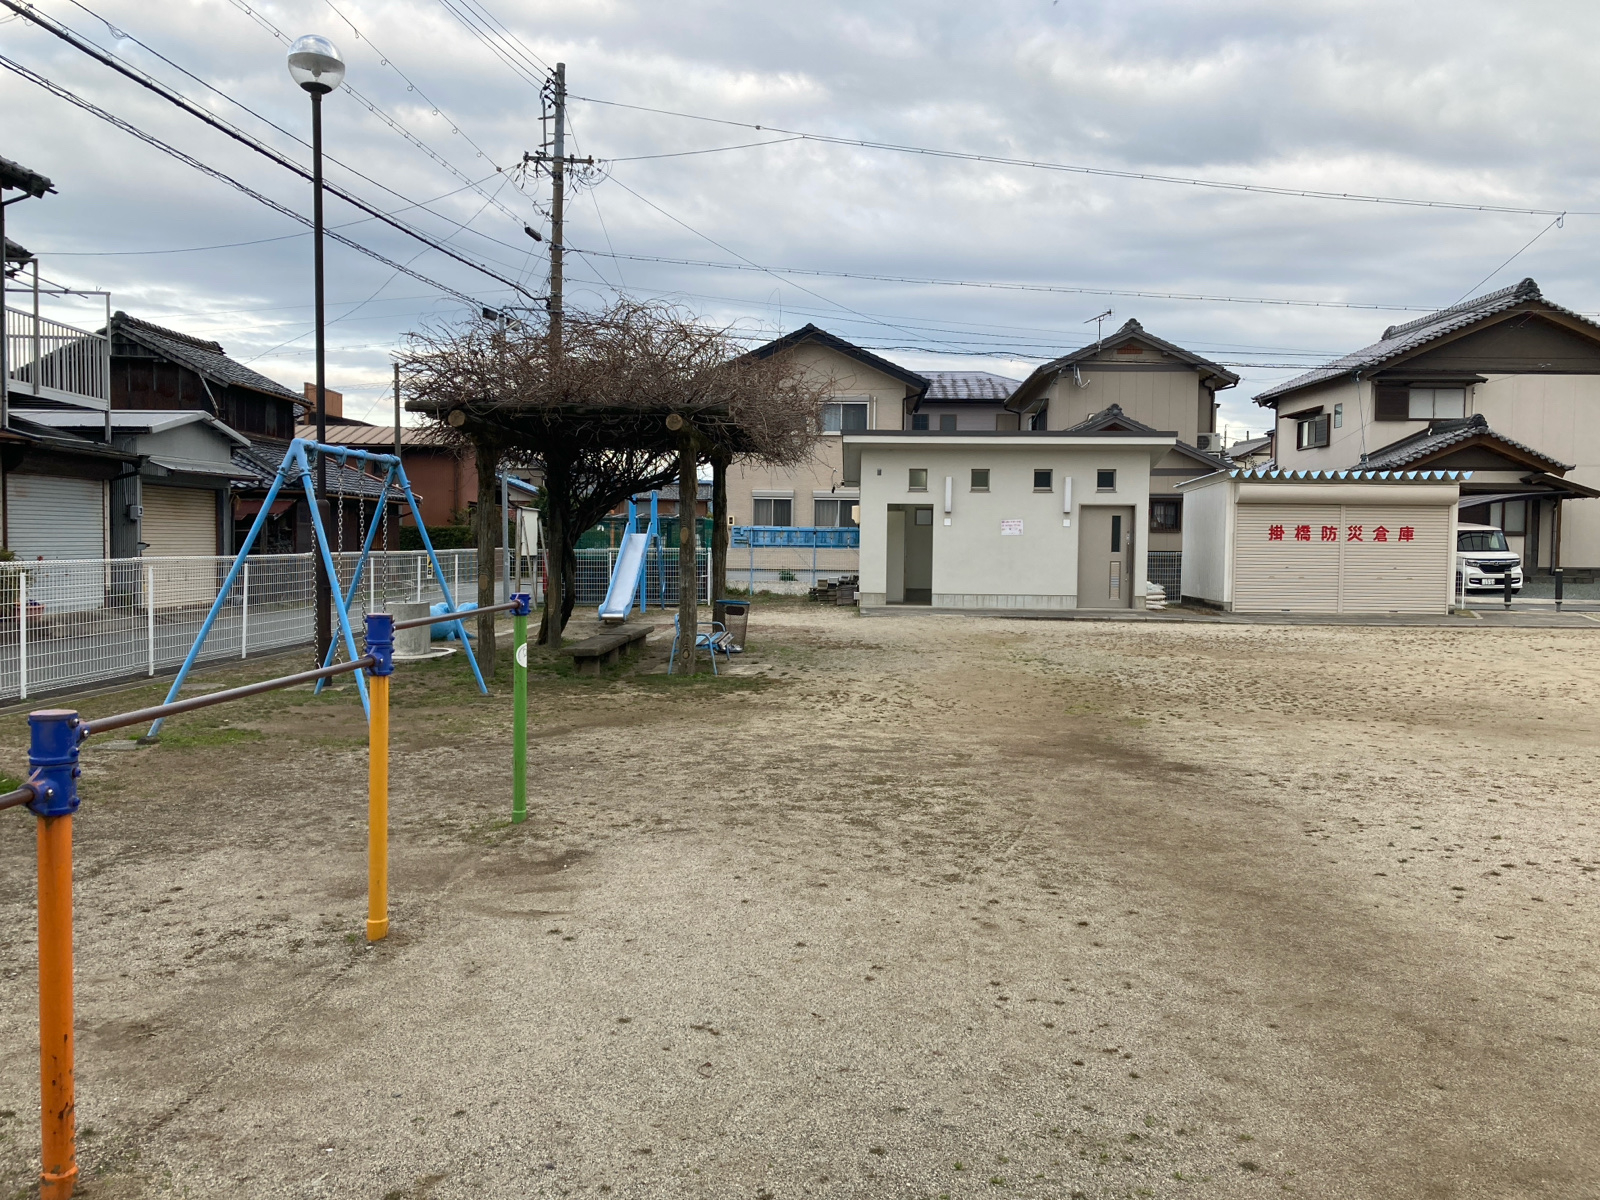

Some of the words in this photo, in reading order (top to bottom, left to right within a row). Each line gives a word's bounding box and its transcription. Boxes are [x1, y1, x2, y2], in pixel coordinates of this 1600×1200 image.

[1268, 525, 1414, 542] 掛橋防災倉庫
